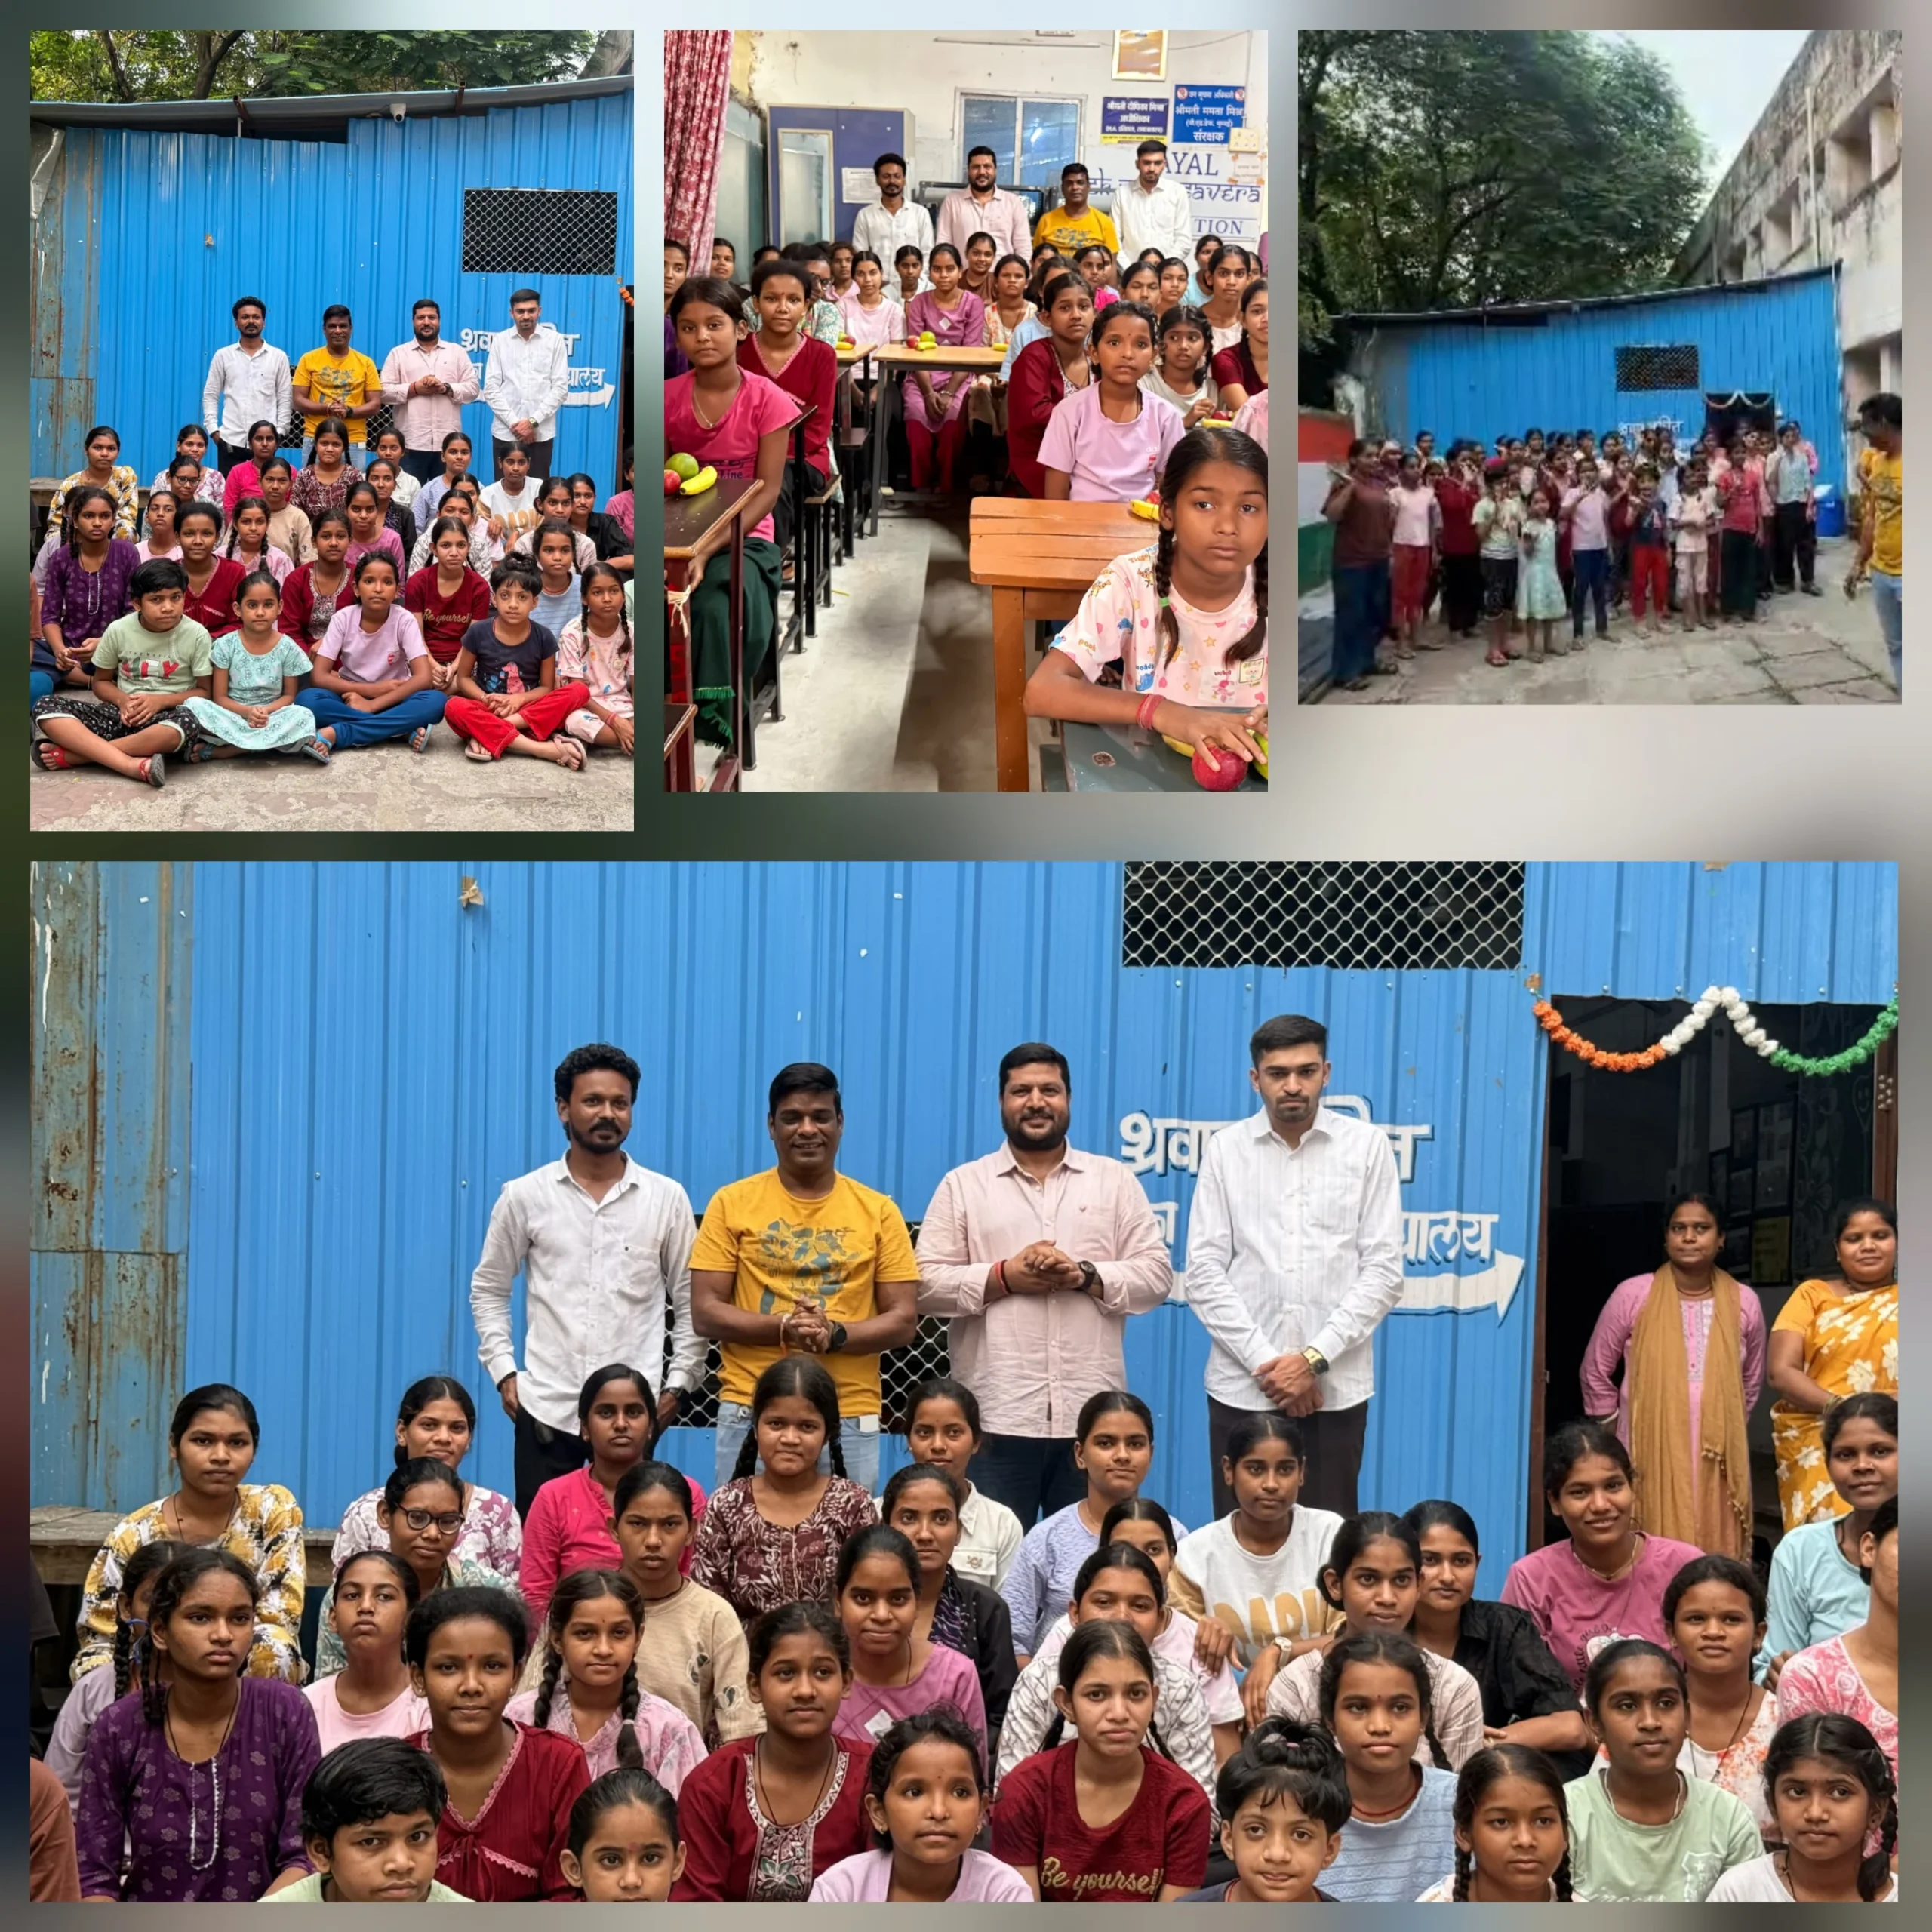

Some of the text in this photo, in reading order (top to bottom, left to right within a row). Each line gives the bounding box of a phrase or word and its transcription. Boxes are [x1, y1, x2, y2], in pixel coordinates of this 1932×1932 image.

[1175, 103, 1200, 115] श्रीमती
[1202, 106, 1224, 116] ममता
[1192, 128, 1225, 142] संरक्षक
[1194, 218, 1244, 235] TION
[1041, 1856, 1070, 1887] Be
